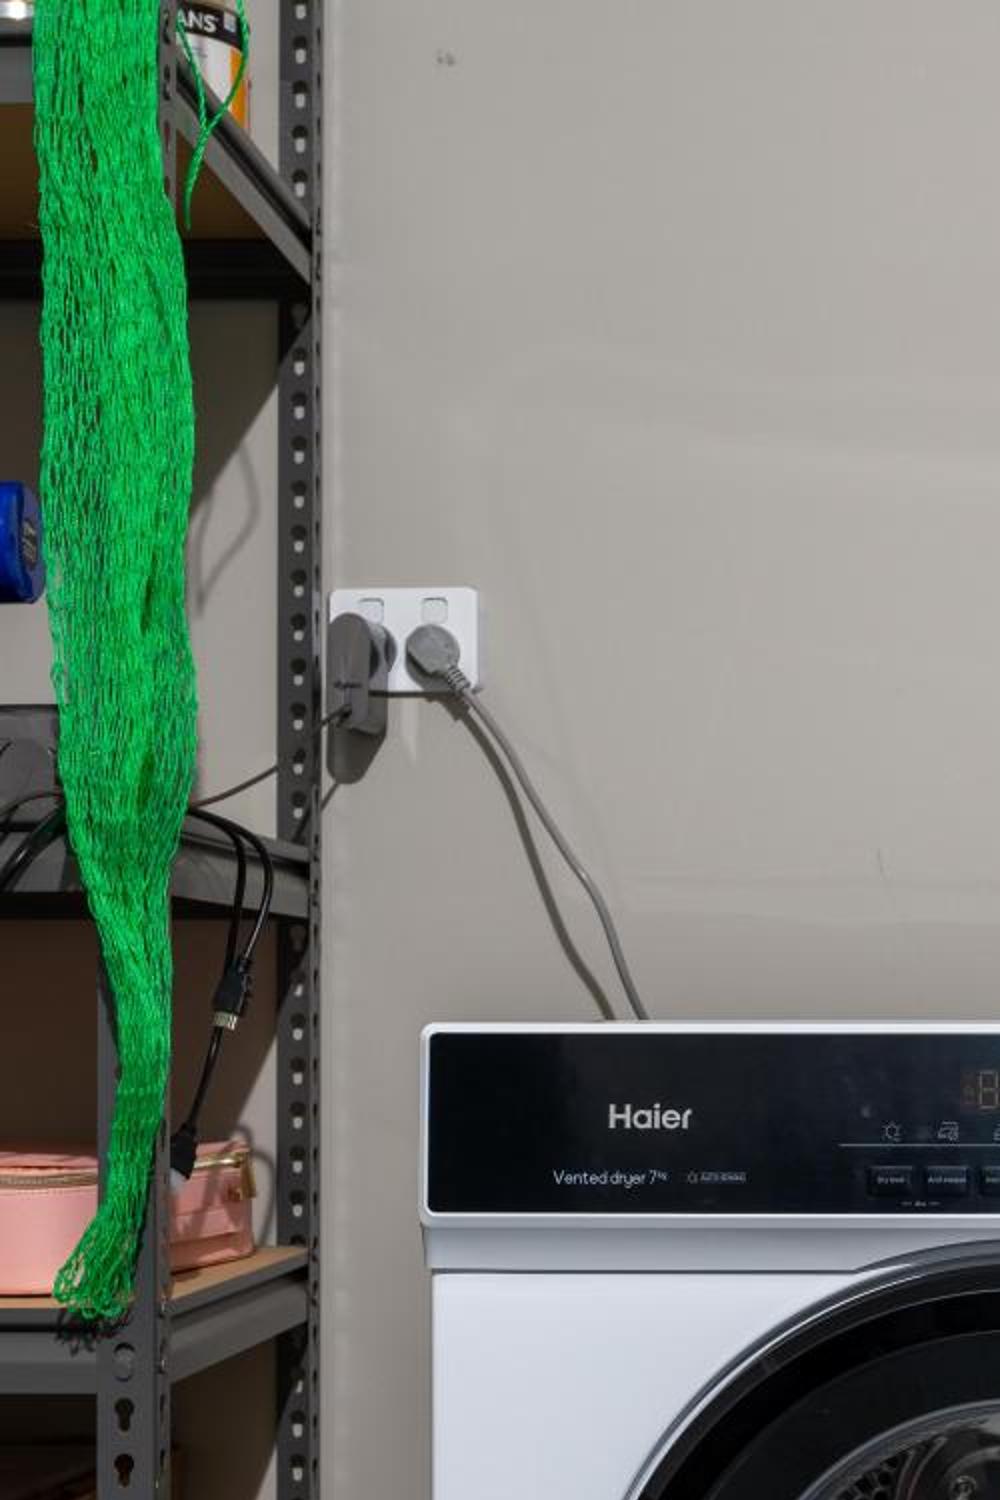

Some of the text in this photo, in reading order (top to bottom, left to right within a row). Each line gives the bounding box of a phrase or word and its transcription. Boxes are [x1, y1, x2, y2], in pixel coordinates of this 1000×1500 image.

[608, 1103, 693, 1130] Haier
[553, 1169, 608, 1185] Vented
[610, 1169, 646, 1189] dryer
